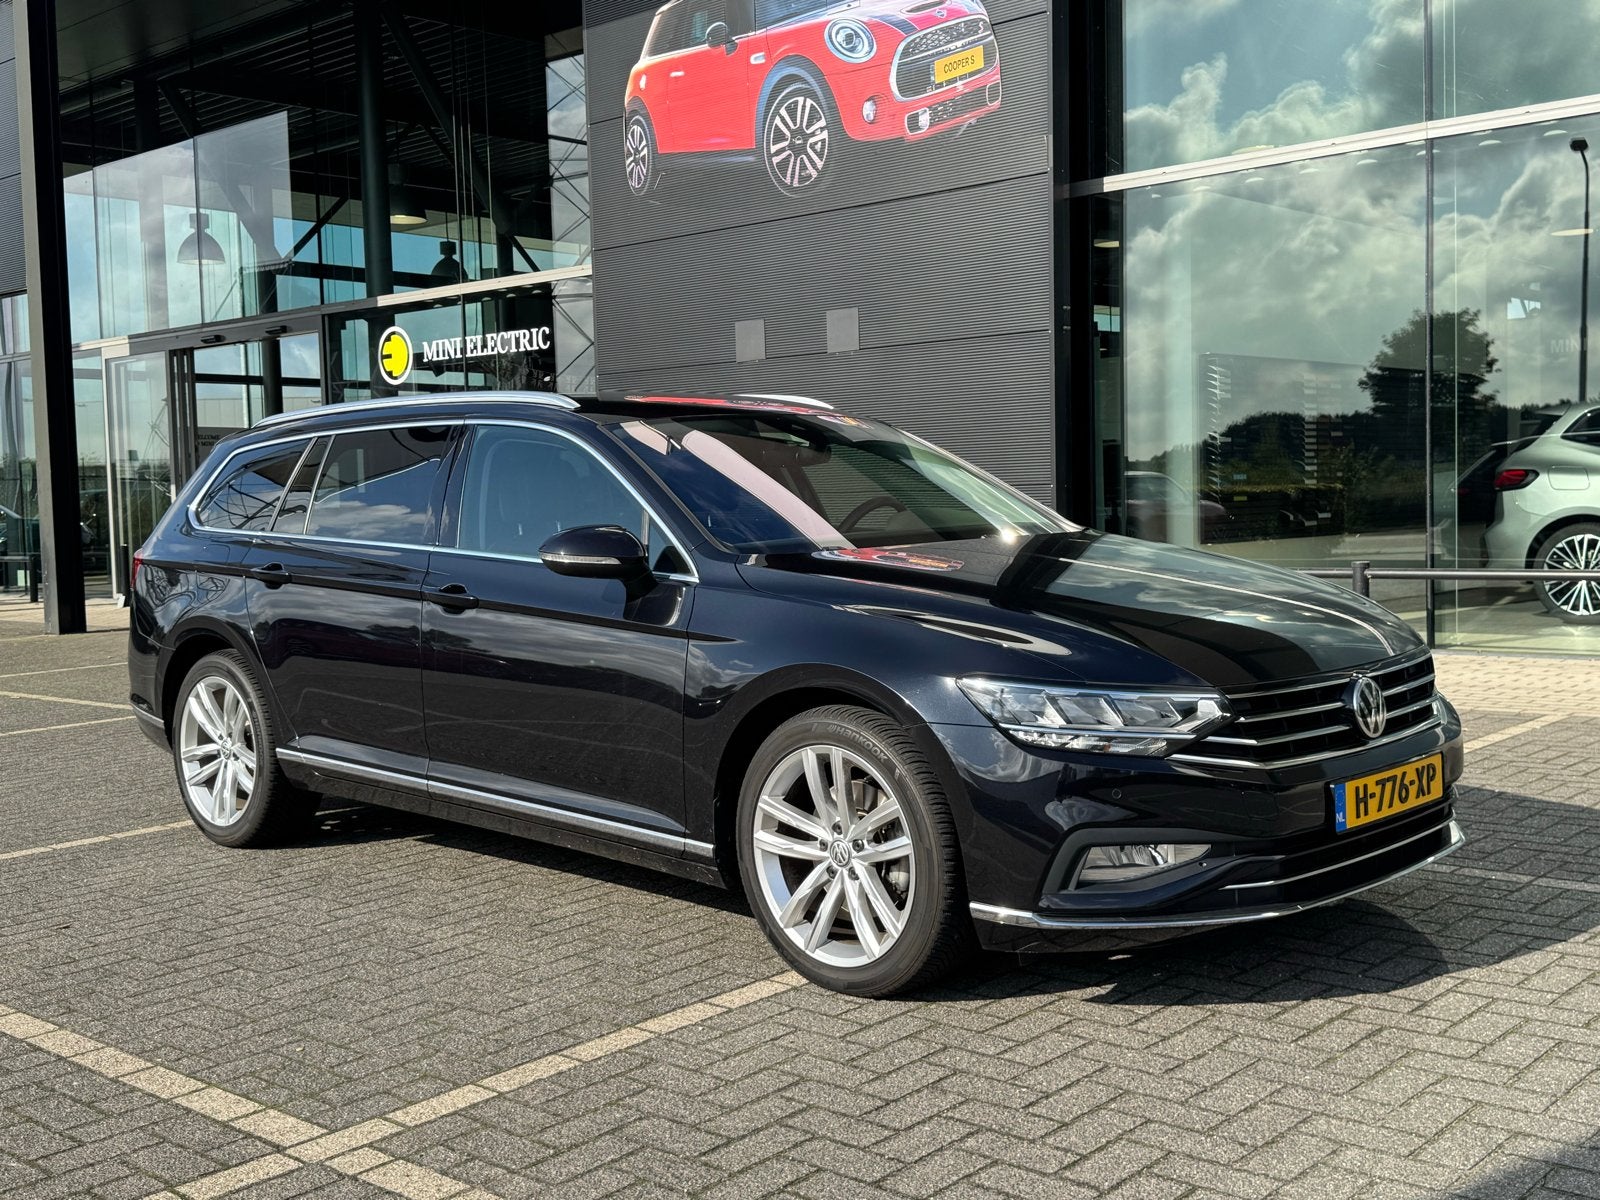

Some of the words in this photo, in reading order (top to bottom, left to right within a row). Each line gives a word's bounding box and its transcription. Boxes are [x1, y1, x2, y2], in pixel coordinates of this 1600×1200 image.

[943, 57, 970, 74] COOPER
[970, 55, 975, 65] S
[422, 337, 463, 363] MINI
[464, 326, 551, 358] ELECTRIC
[1355, 763, 1437, 819] H-776-XP
[1335, 812, 1345, 823] NL
